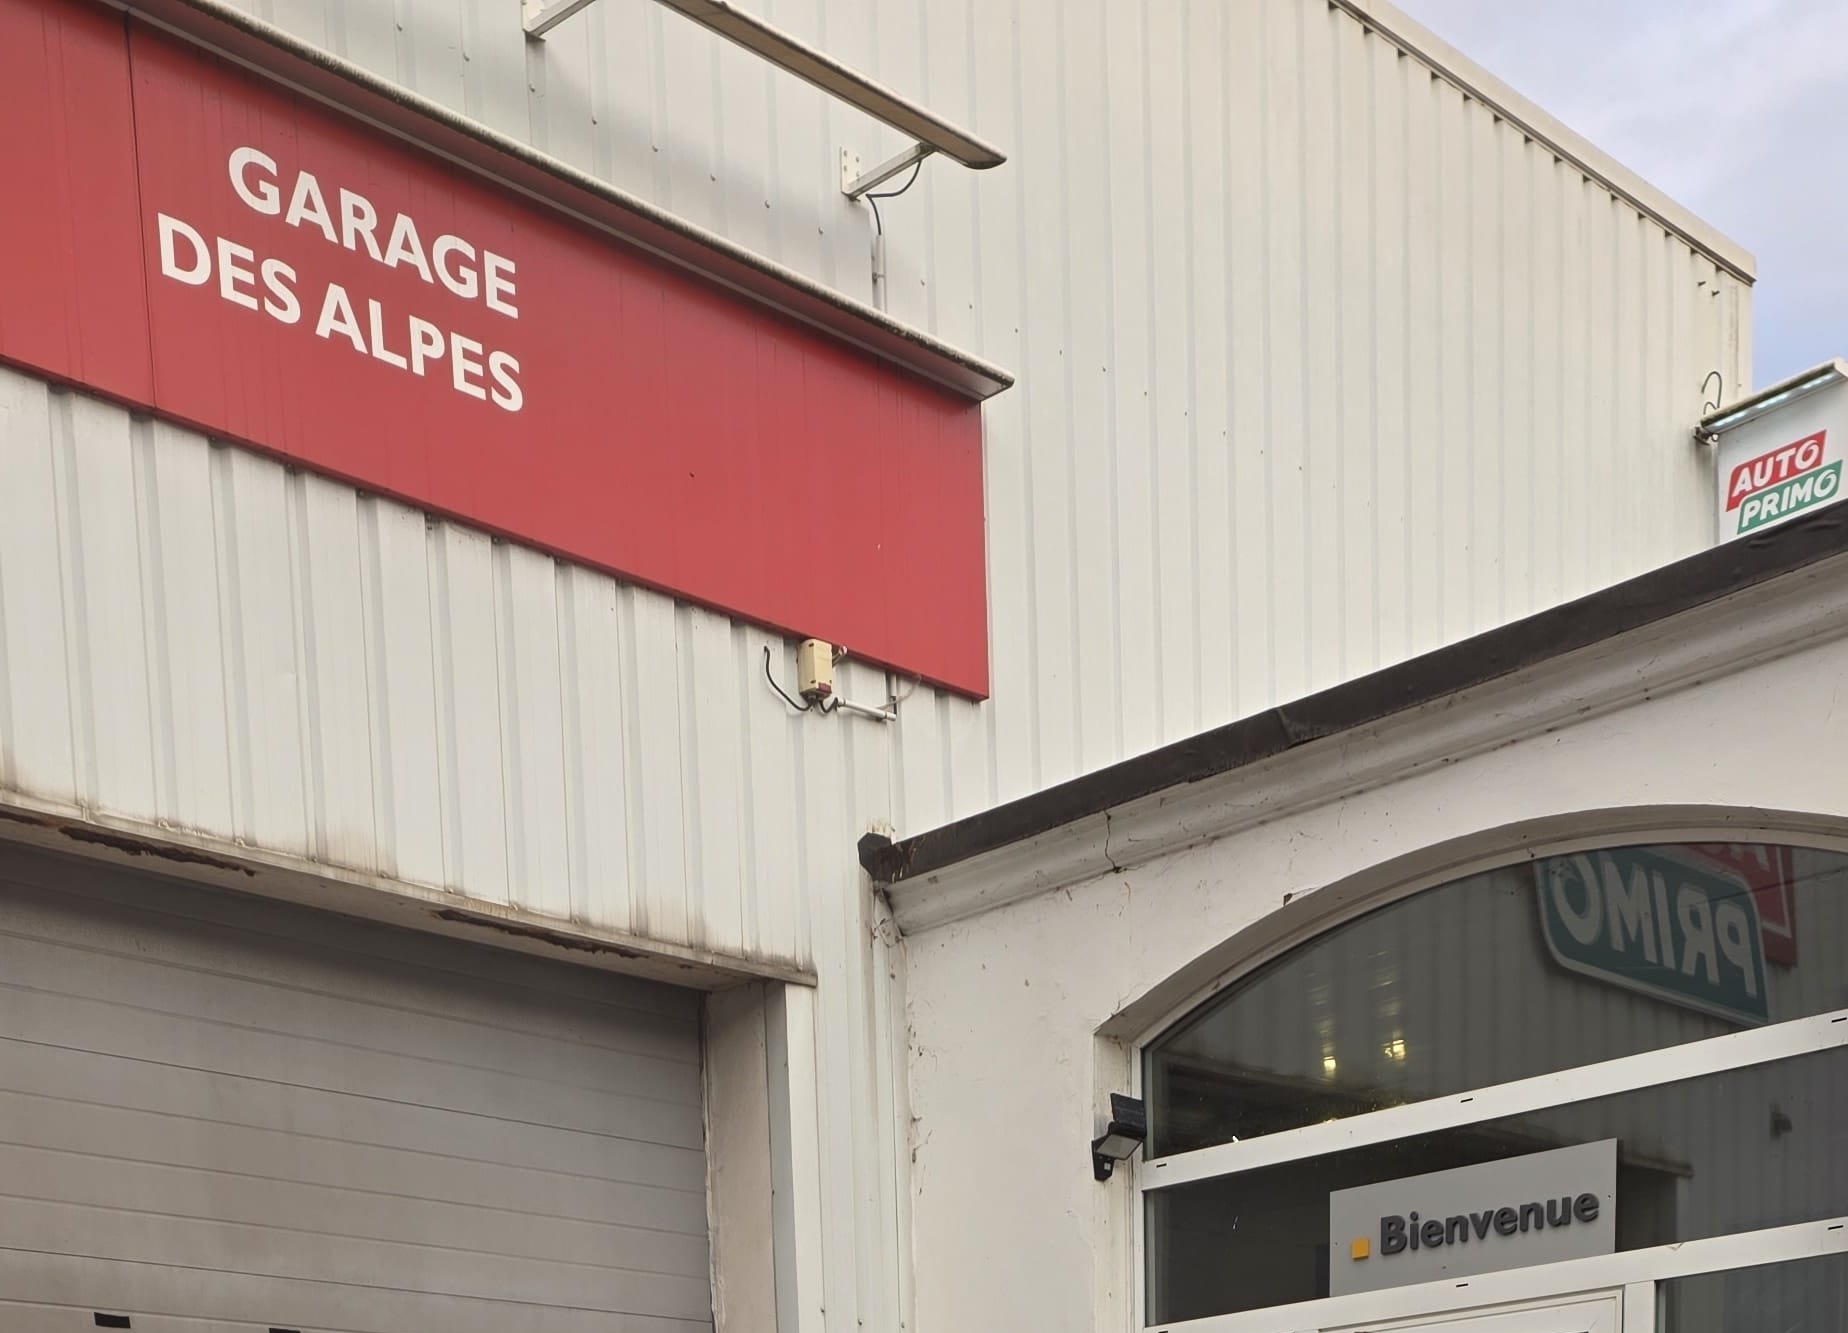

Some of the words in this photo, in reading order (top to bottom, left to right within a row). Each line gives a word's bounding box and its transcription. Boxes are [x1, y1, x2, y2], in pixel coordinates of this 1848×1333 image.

[228, 146, 519, 319] GARAGE
[157, 212, 301, 324] DES
[315, 282, 524, 412] ALPES
[1731, 439, 1820, 498] AUTO
[1742, 468, 1838, 528] PRIMO
[1380, 1192, 1600, 1256] Bienvenue
